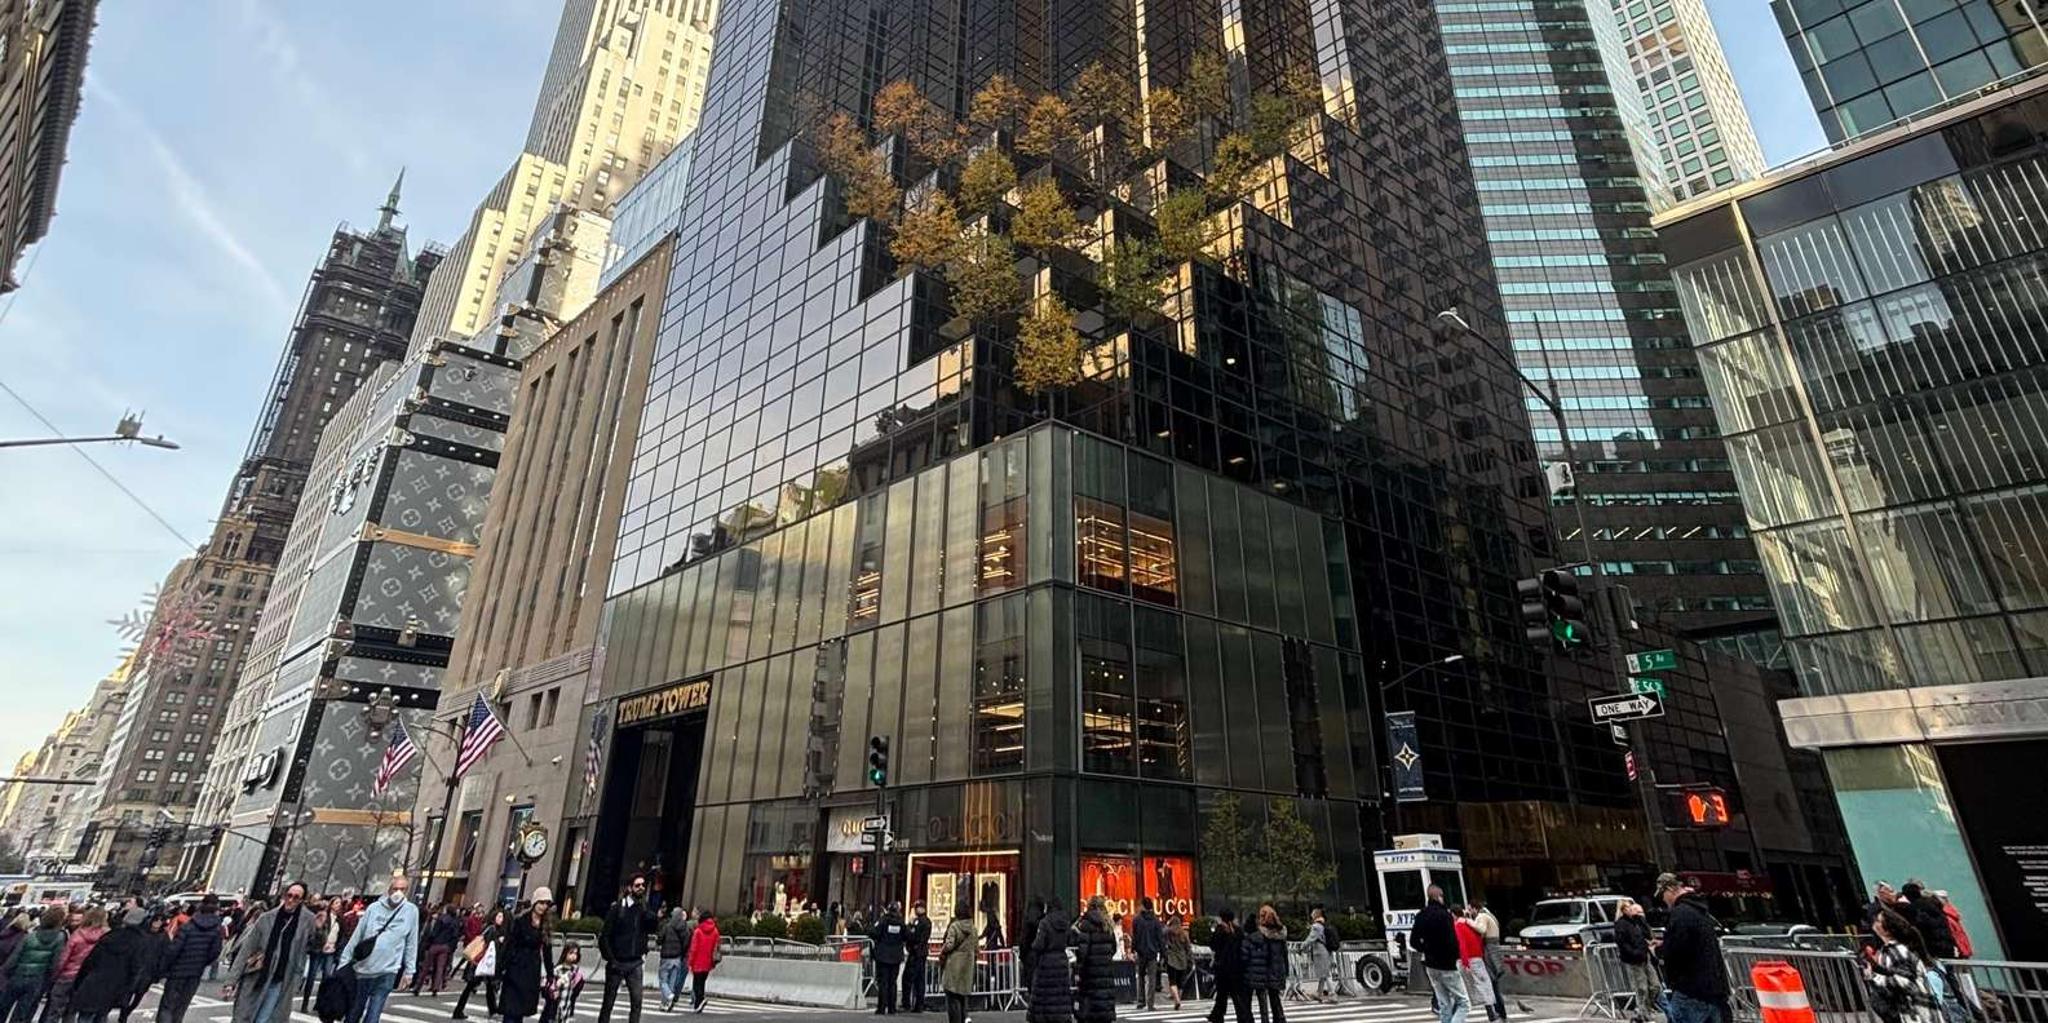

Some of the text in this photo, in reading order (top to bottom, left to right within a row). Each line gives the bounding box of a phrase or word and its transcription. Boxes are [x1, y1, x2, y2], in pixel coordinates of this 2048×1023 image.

[1645, 655, 1654, 669] 5
[618, 681, 710, 724] TRUMP TOWER
[1601, 700, 1649, 715] ONE WAY
[1712, 795, 1727, 822] 3
[1152, 898, 1195, 916] UCCI
[1397, 912, 1416, 925] NYP
[1502, 959, 1566, 977] TOP
